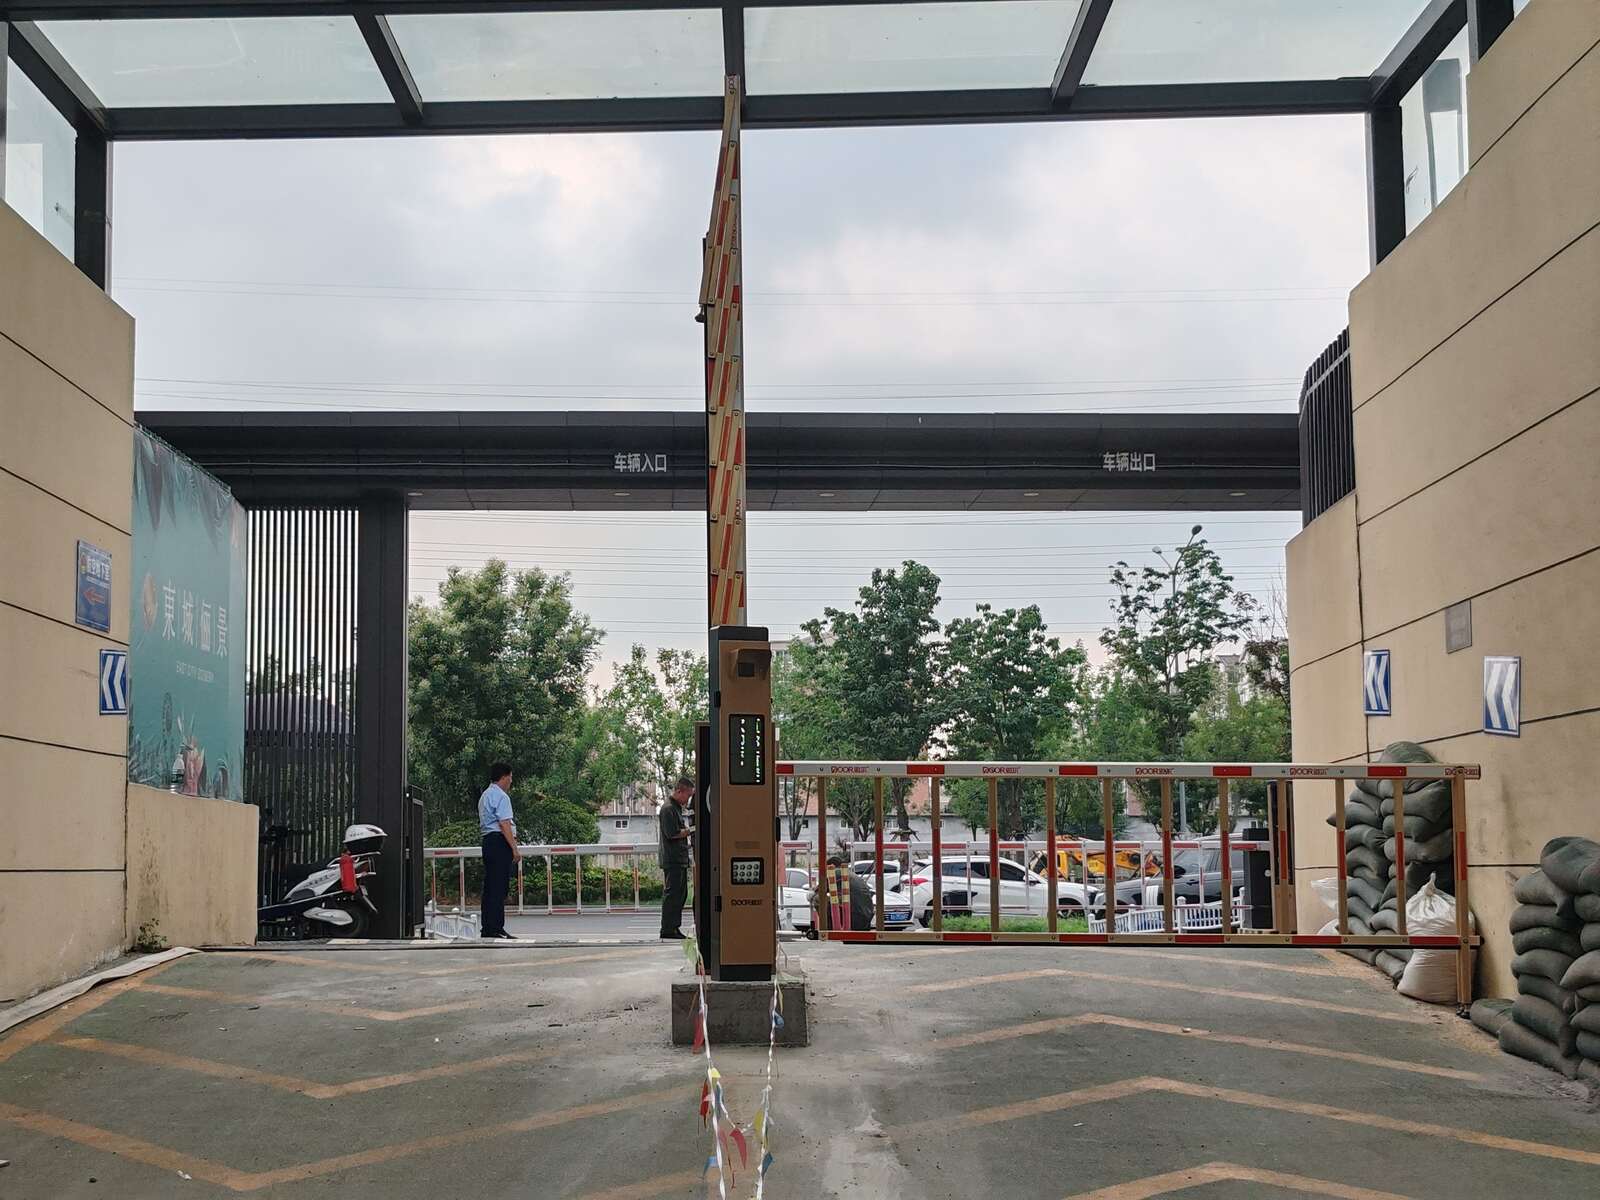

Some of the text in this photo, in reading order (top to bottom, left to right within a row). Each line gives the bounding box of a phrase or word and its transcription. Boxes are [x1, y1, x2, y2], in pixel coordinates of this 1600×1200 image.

[614, 452, 667, 473] 车辆入口
[1103, 451, 1156, 472] 车辆出口
